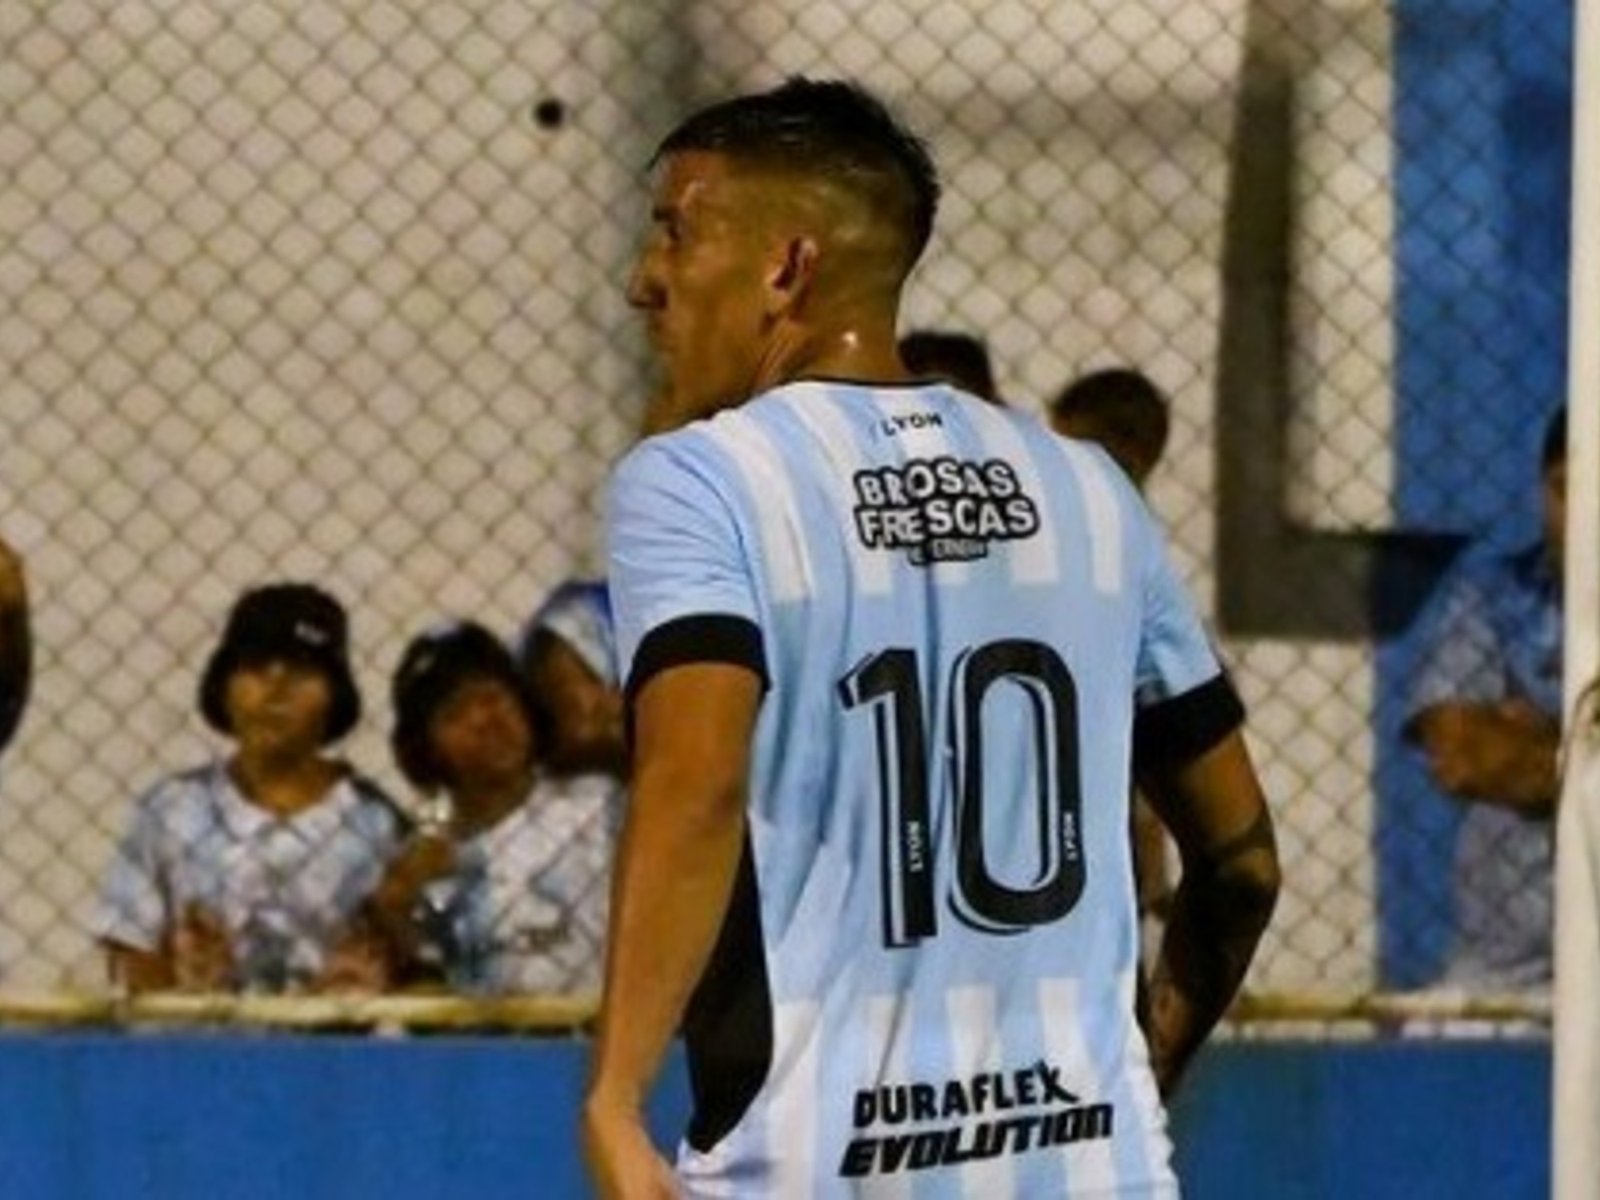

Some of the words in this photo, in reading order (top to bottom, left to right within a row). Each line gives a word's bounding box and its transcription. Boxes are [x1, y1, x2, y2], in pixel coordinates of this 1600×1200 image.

[858, 498, 1036, 546] FRESCAS
[838, 639, 1087, 949] 10
[853, 1059, 1081, 1128] DURAFLEX
[839, 1104, 1114, 1177] EVOLUTION
